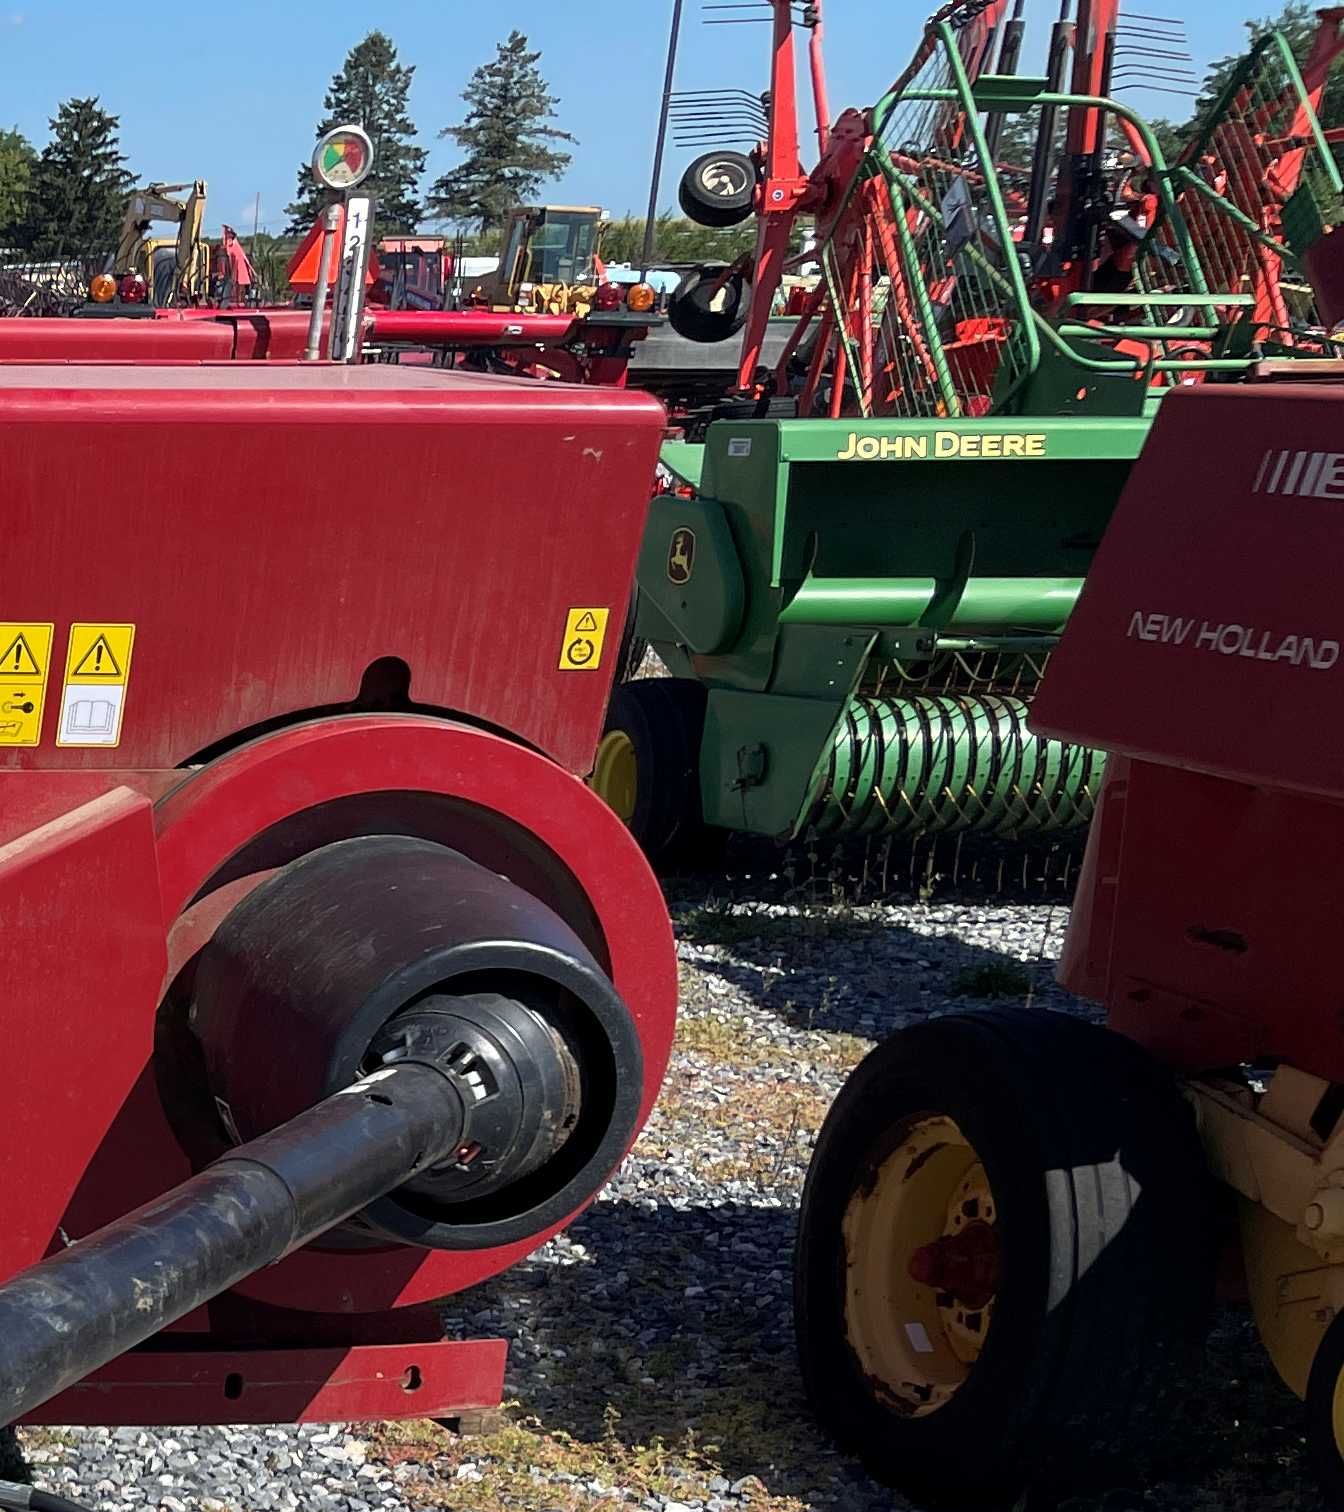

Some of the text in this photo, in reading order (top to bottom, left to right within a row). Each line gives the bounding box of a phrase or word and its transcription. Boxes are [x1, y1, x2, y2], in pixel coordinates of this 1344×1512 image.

[353, 212, 360, 228] 1
[349, 235, 360, 251] 2
[837, 431, 1046, 460] JOHN DEERE
[1126, 611, 1340, 670] NEW HOLLAND
